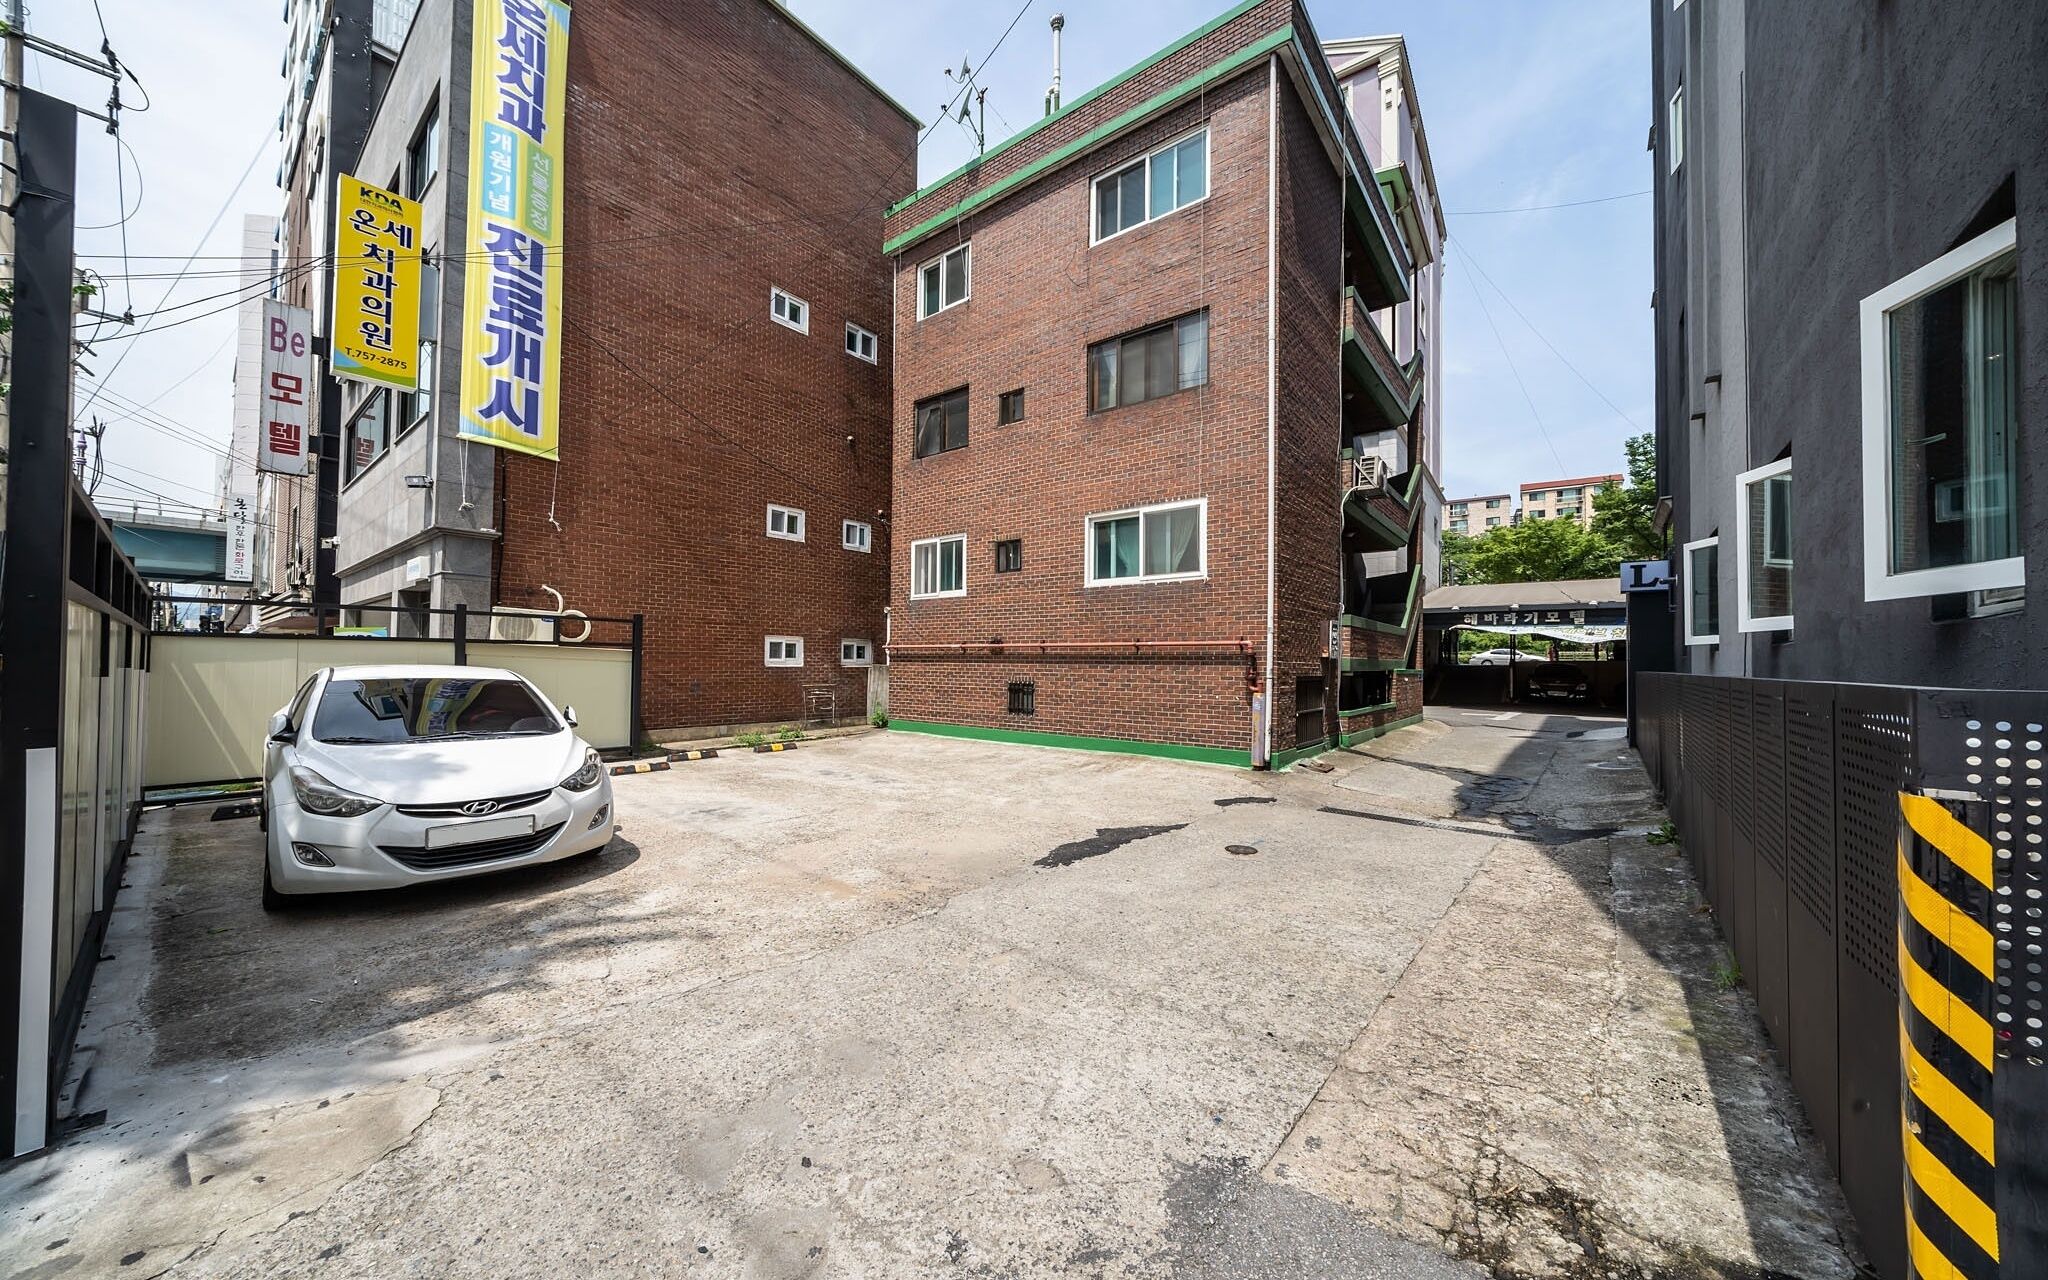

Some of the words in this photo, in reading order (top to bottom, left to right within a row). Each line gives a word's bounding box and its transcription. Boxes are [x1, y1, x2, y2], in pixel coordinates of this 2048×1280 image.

[360, 186, 403, 212] KDA
[490, 131, 512, 213] 개원기념
[349, 209, 412, 250] 온세
[360, 243, 398, 352] 치과의원
[270, 316, 305, 358] Be
[344, 346, 408, 370] T.757-2875
[478, 222, 544, 436] 진료개시
[269, 371, 303, 457] 모텔
